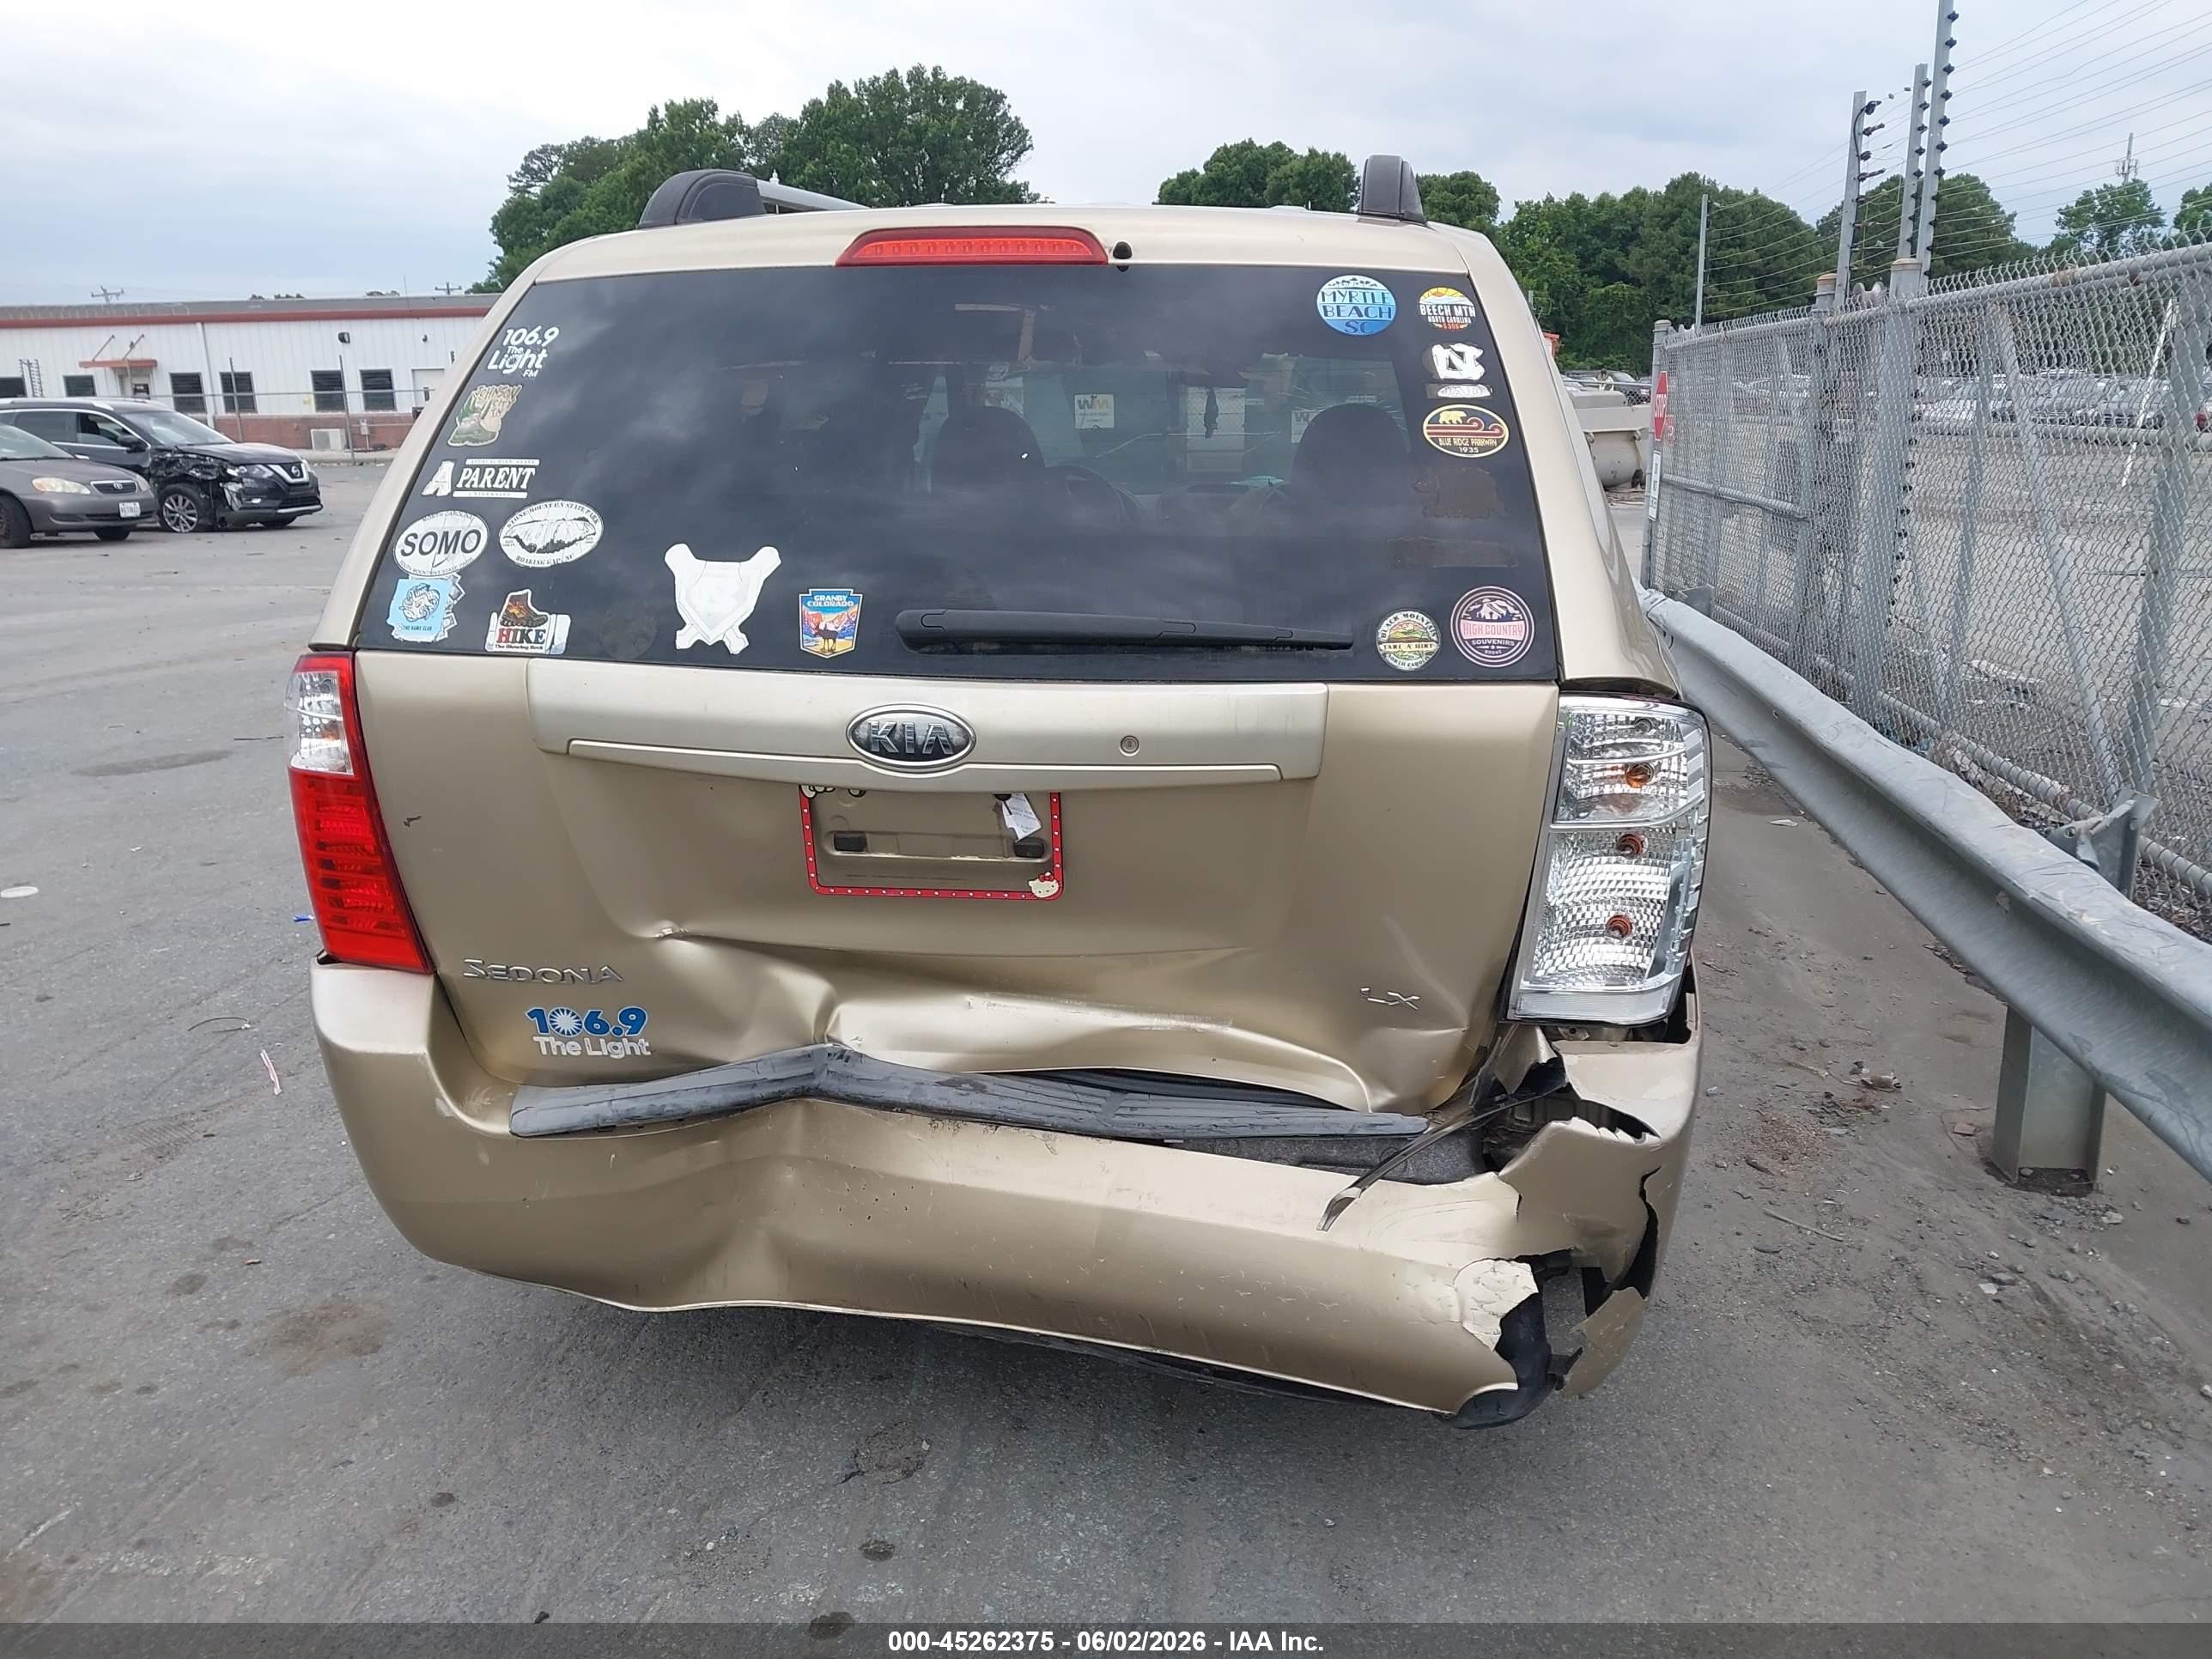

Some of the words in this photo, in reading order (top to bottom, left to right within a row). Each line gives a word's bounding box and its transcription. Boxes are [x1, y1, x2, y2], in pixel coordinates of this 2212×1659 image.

[1321, 289, 1391, 304] MYRTLE
[1322, 305, 1392, 319] BEACH
[1419, 304, 1451, 316] BEECH
[1453, 305, 1476, 317] MTN
[503, 325, 560, 347] 106.9
[1344, 320, 1375, 333] SC
[507, 345, 525, 355] The
[487, 349, 549, 374] Light
[522, 368, 539, 378] FM
[1438, 437, 1452, 446] BLUE
[1452, 437, 1470, 446] RIDGE
[1470, 438, 1498, 447] PARKWAY
[455, 466, 536, 489] PARENT
[565, 501, 585, 512] STATE
[584, 509, 601, 525] PARK
[400, 528, 482, 557] SOMO
[495, 628, 547, 645] HIKE
[1380, 615, 1400, 639] BLACK
[1462, 623, 1484, 635] HIGH
[1485, 624, 1523, 636] COUNTRY
[867, 720, 954, 755] KIA
[463, 958, 624, 983] SEDONA
[1359, 988, 1421, 1011] LX
[526, 1006, 648, 1037] 106.9
[532, 1036, 582, 1056] The
[586, 1036, 652, 1060] Light
